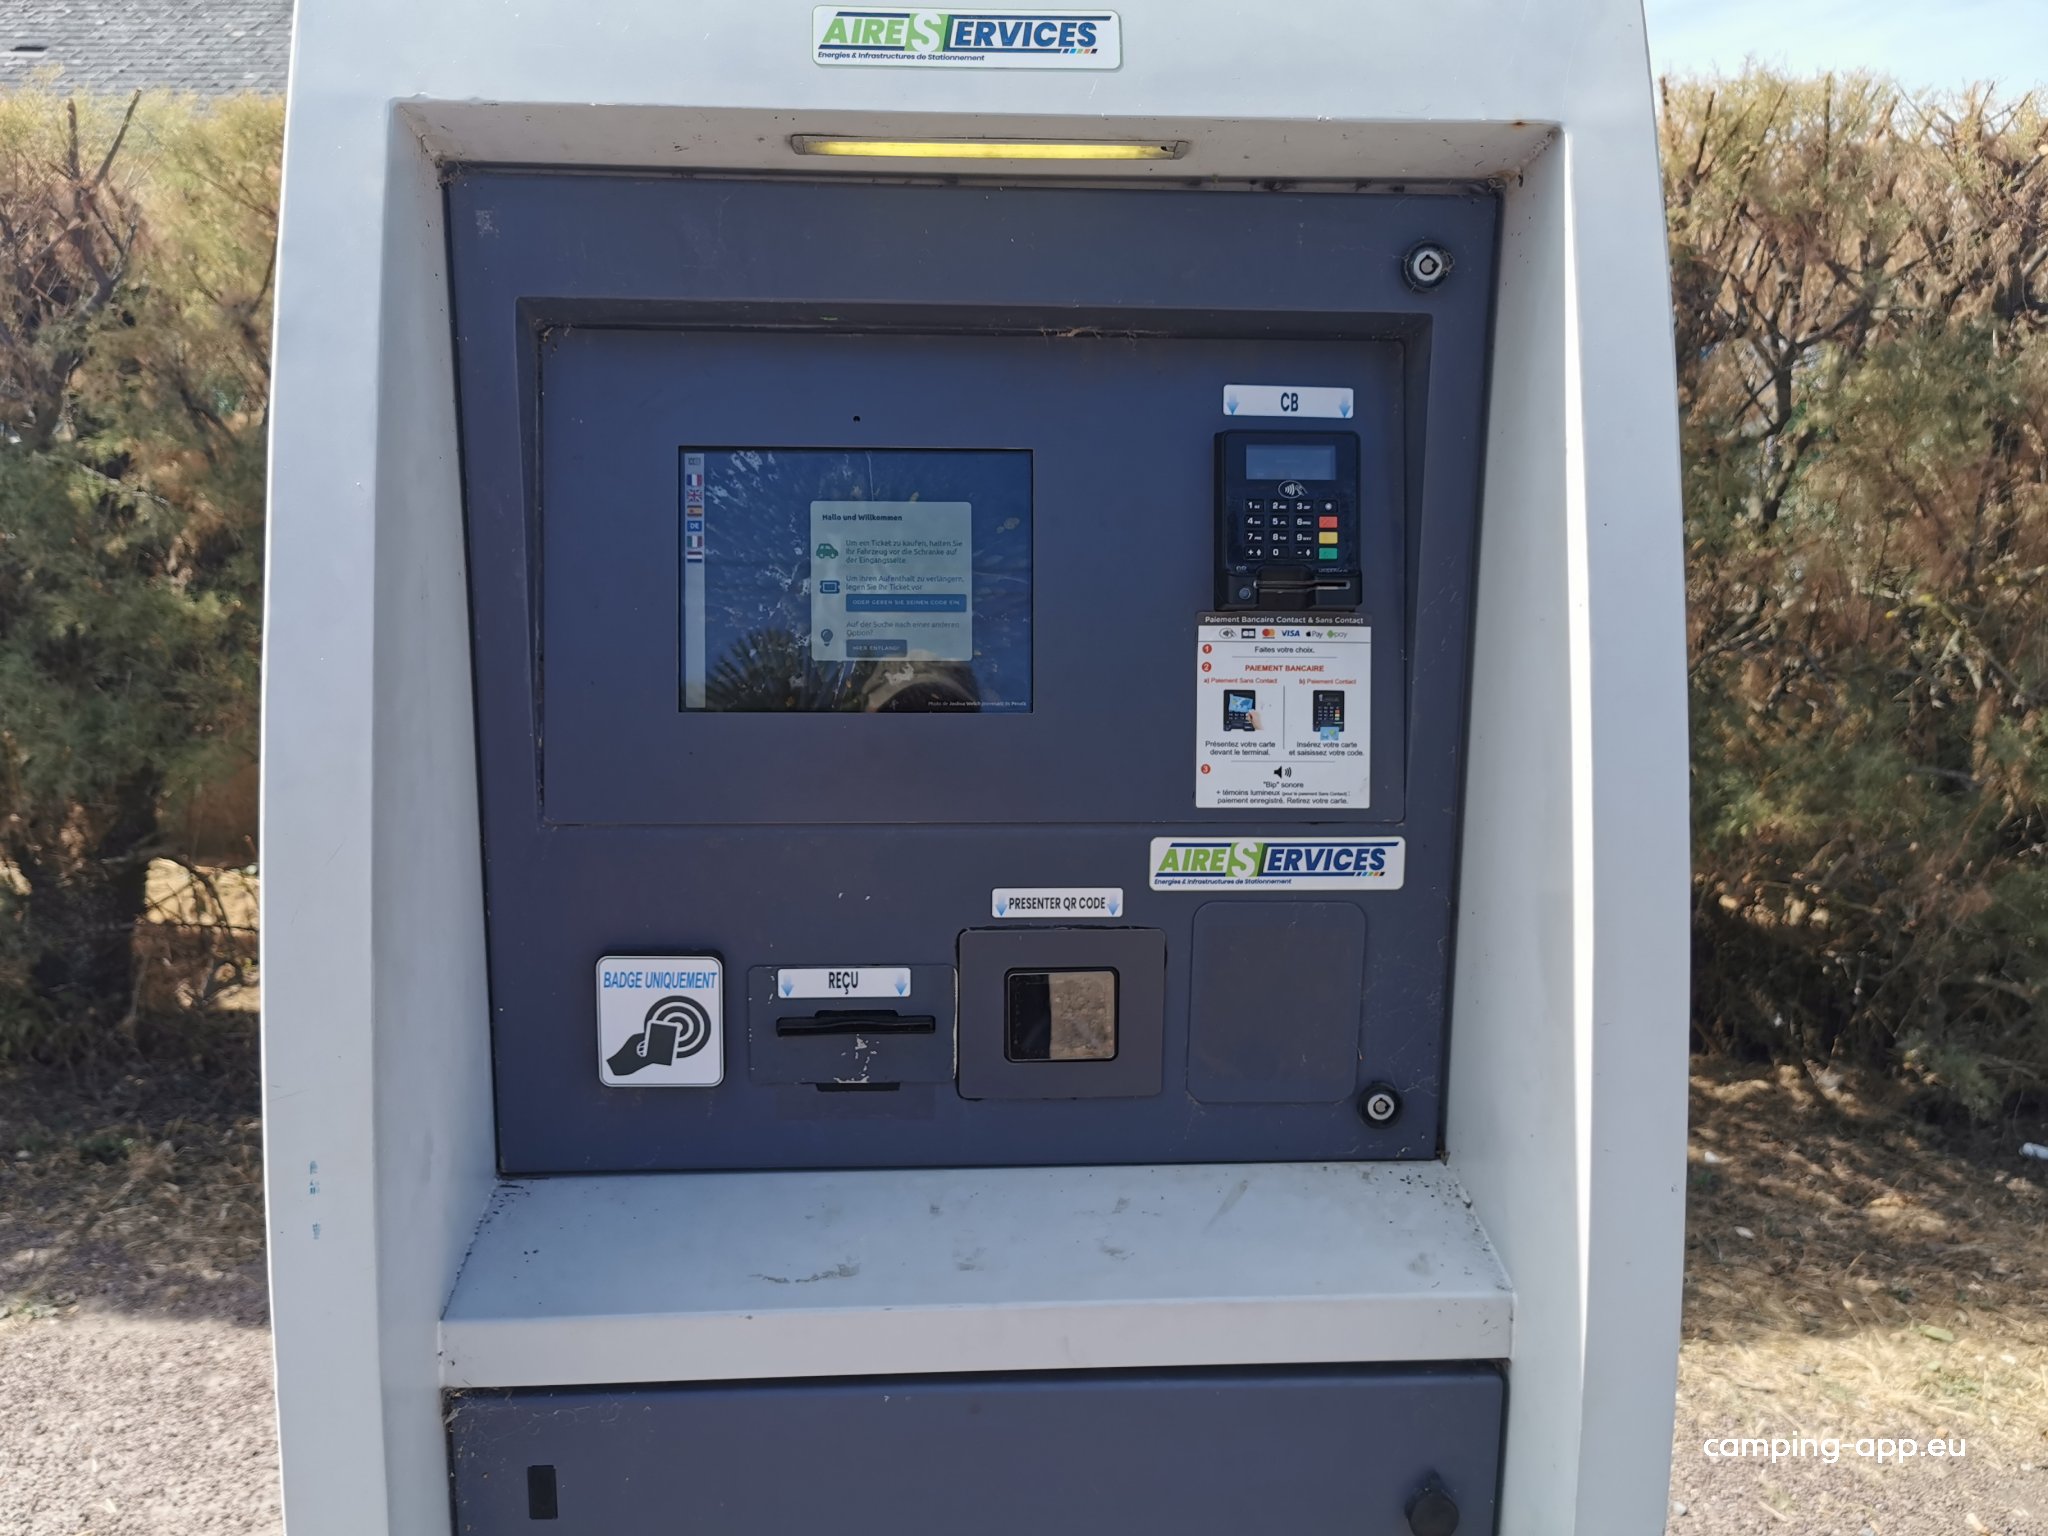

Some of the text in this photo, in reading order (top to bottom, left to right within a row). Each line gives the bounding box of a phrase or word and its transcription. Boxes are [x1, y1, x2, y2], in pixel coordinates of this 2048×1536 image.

[817, 51, 851, 59] Energies
[858, 52, 915, 60] Infrastructures
[928, 53, 985, 61] Stationnement
[1280, 392, 1299, 412] CB
[1296, 502, 1303, 510] 3
[1247, 517, 1253, 525] 4
[1272, 517, 1278, 525] 5
[1296, 518, 1303, 526] 6
[1296, 533, 1303, 541] 9
[856, 548, 888, 556] Fahrzeug
[913, 548, 944, 556] Schranke
[1281, 629, 1300, 637] VISA
[1154, 878, 1181, 886] Energies
[1008, 896, 1106, 911] PRESENTER QR CODE
[603, 971, 717, 990] BADGE UNIQUEMENT
[828, 971, 859, 995] REÇU
